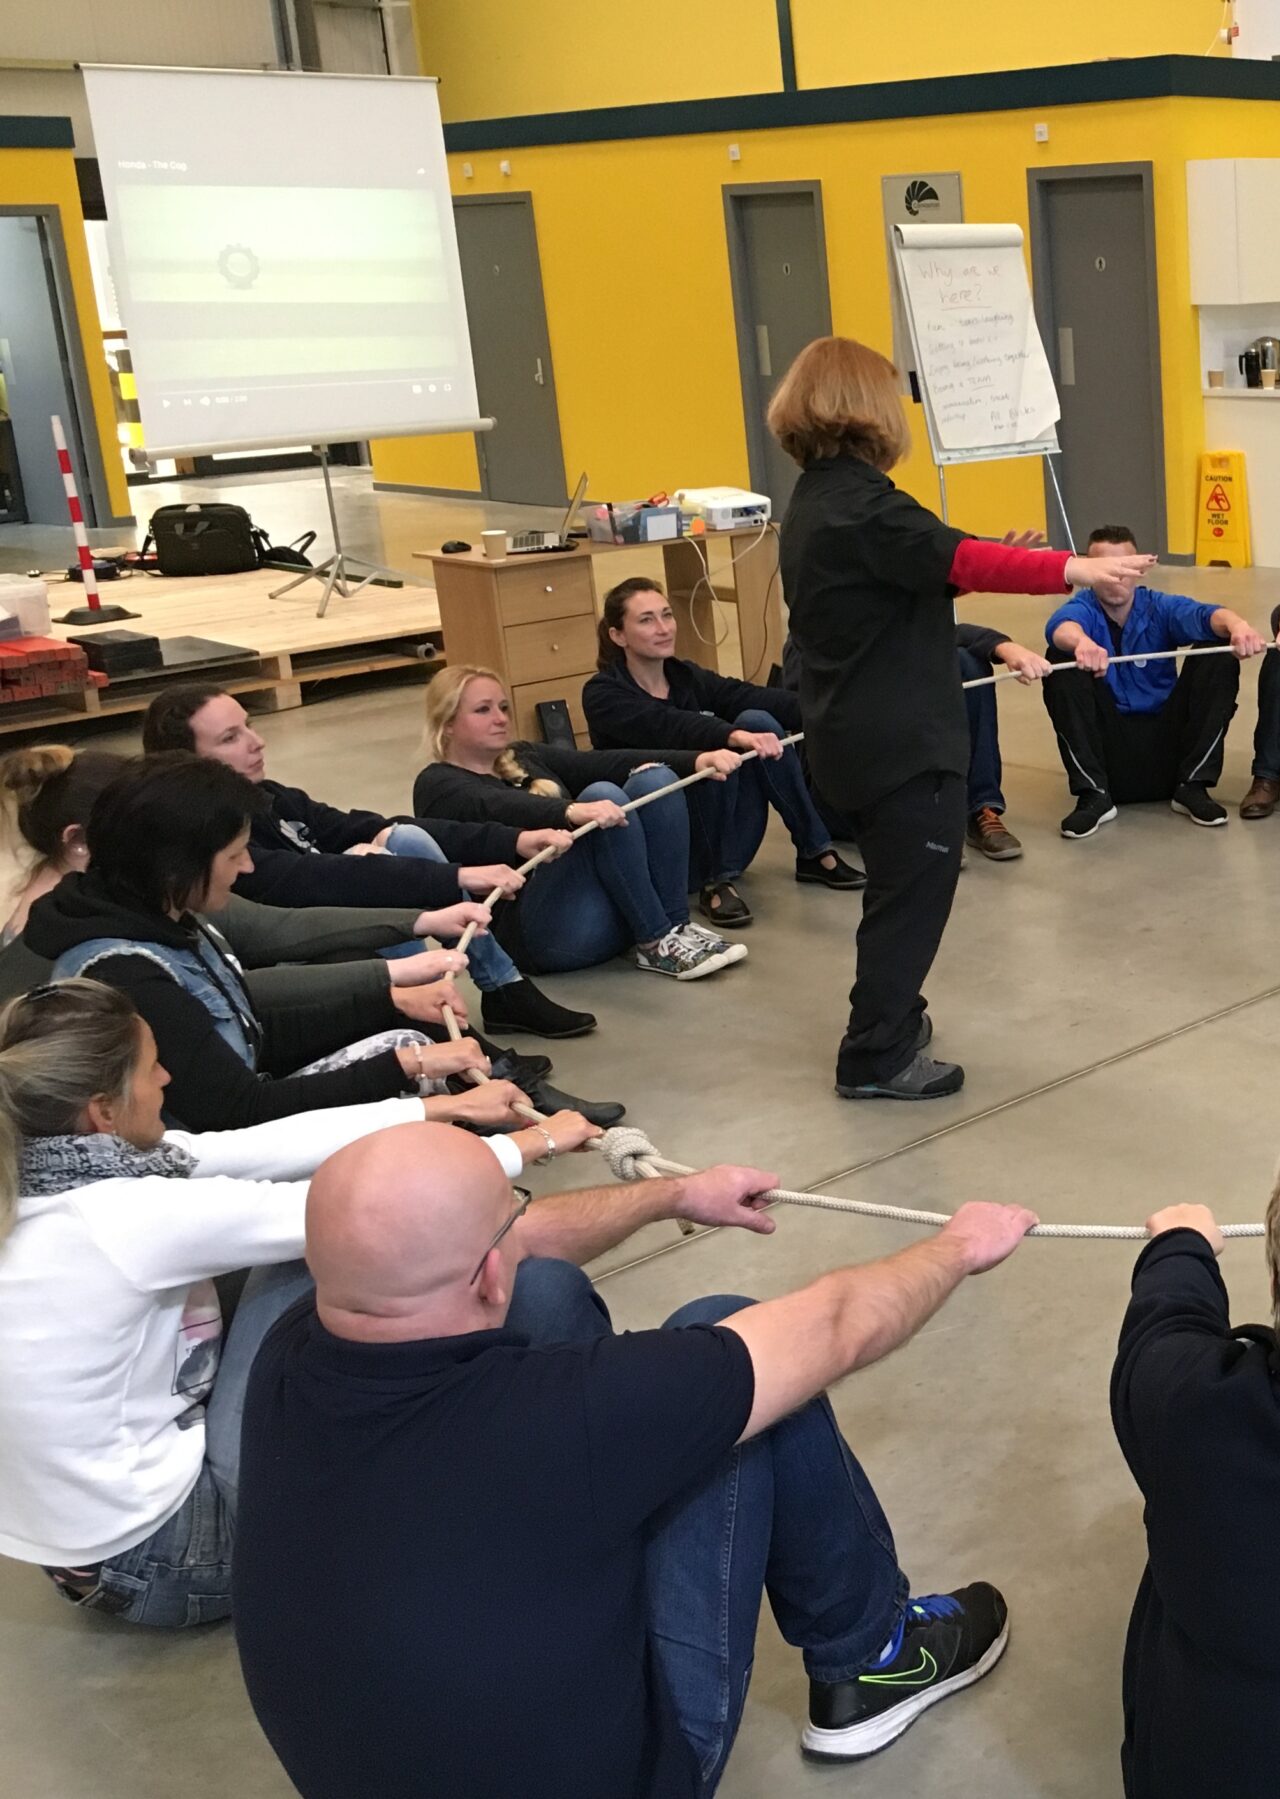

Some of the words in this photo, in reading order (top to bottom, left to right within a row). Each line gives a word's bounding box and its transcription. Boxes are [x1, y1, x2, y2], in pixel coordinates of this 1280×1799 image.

[152, 160, 168, 169] The
[918, 261, 953, 287] Why
[939, 283, 982, 304] here?
